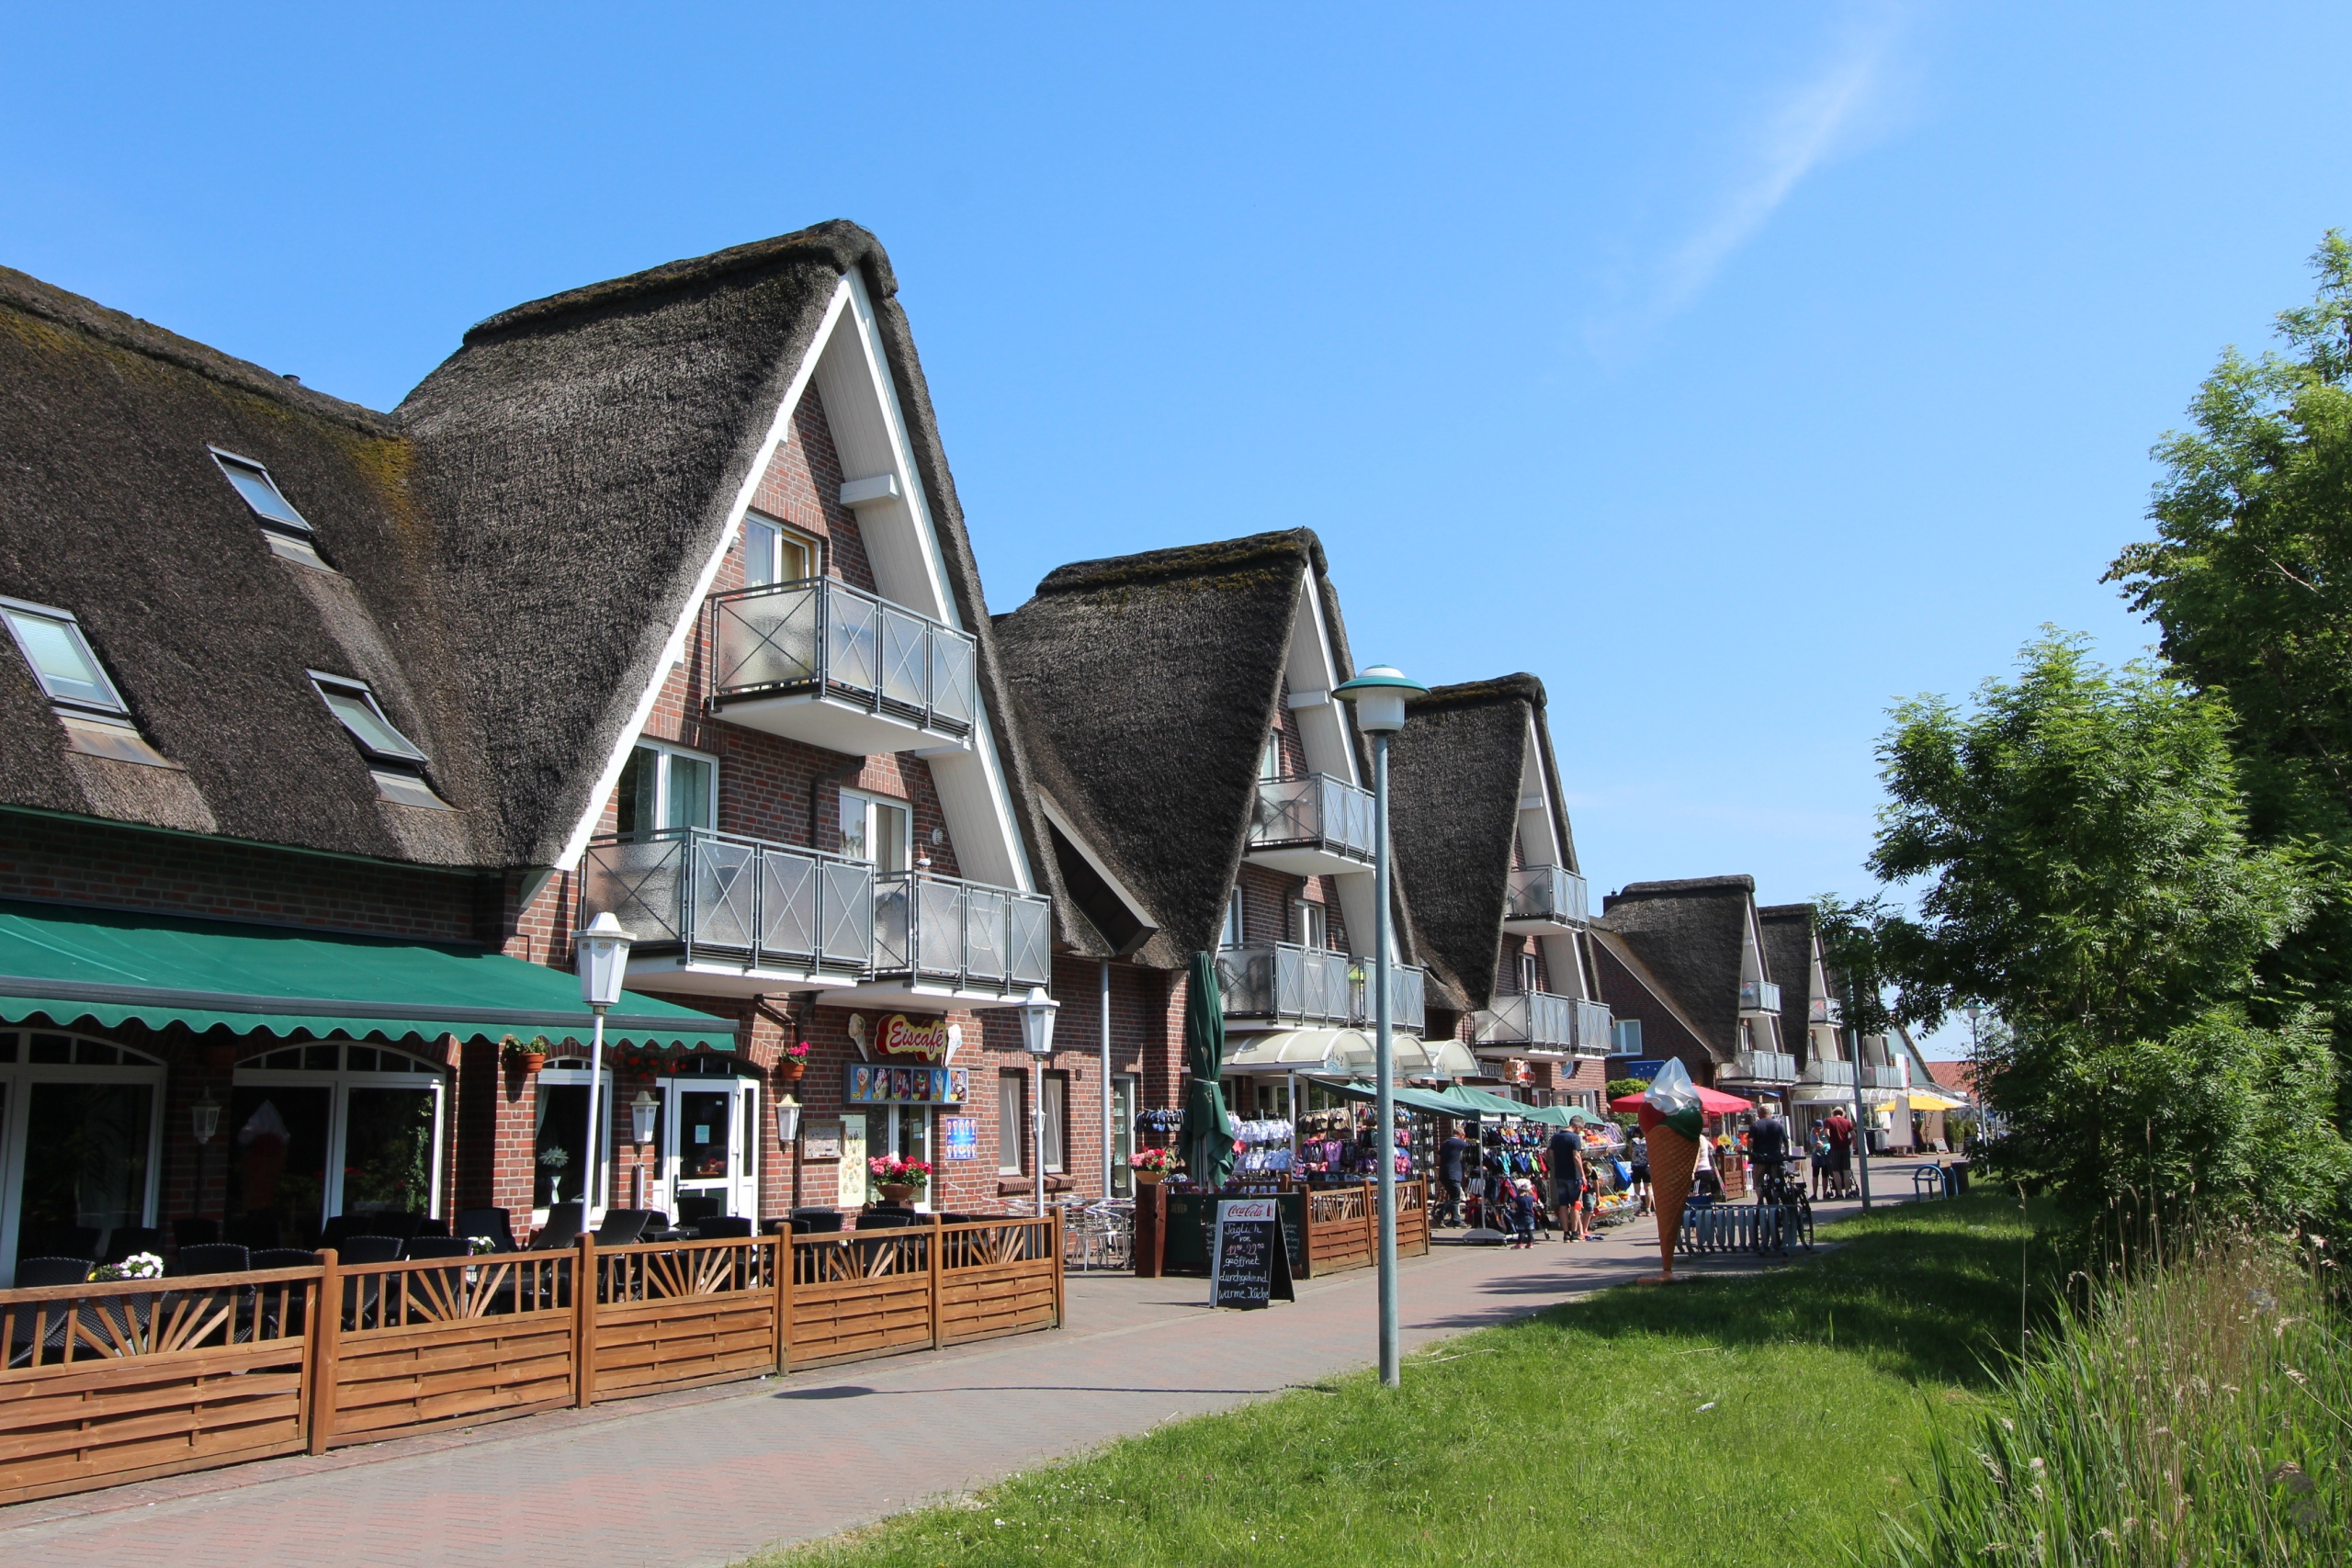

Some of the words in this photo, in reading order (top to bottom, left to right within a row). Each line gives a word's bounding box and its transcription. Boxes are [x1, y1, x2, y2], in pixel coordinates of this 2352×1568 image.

[889, 1020, 944, 1055] Eiscafé
[1477, 1060, 1502, 1077] ÄCKEREI
[1223, 1256, 1260, 1268] geöffnet
[1219, 1290, 1246, 1300] warme
[1248, 1287, 1269, 1301] Küche
